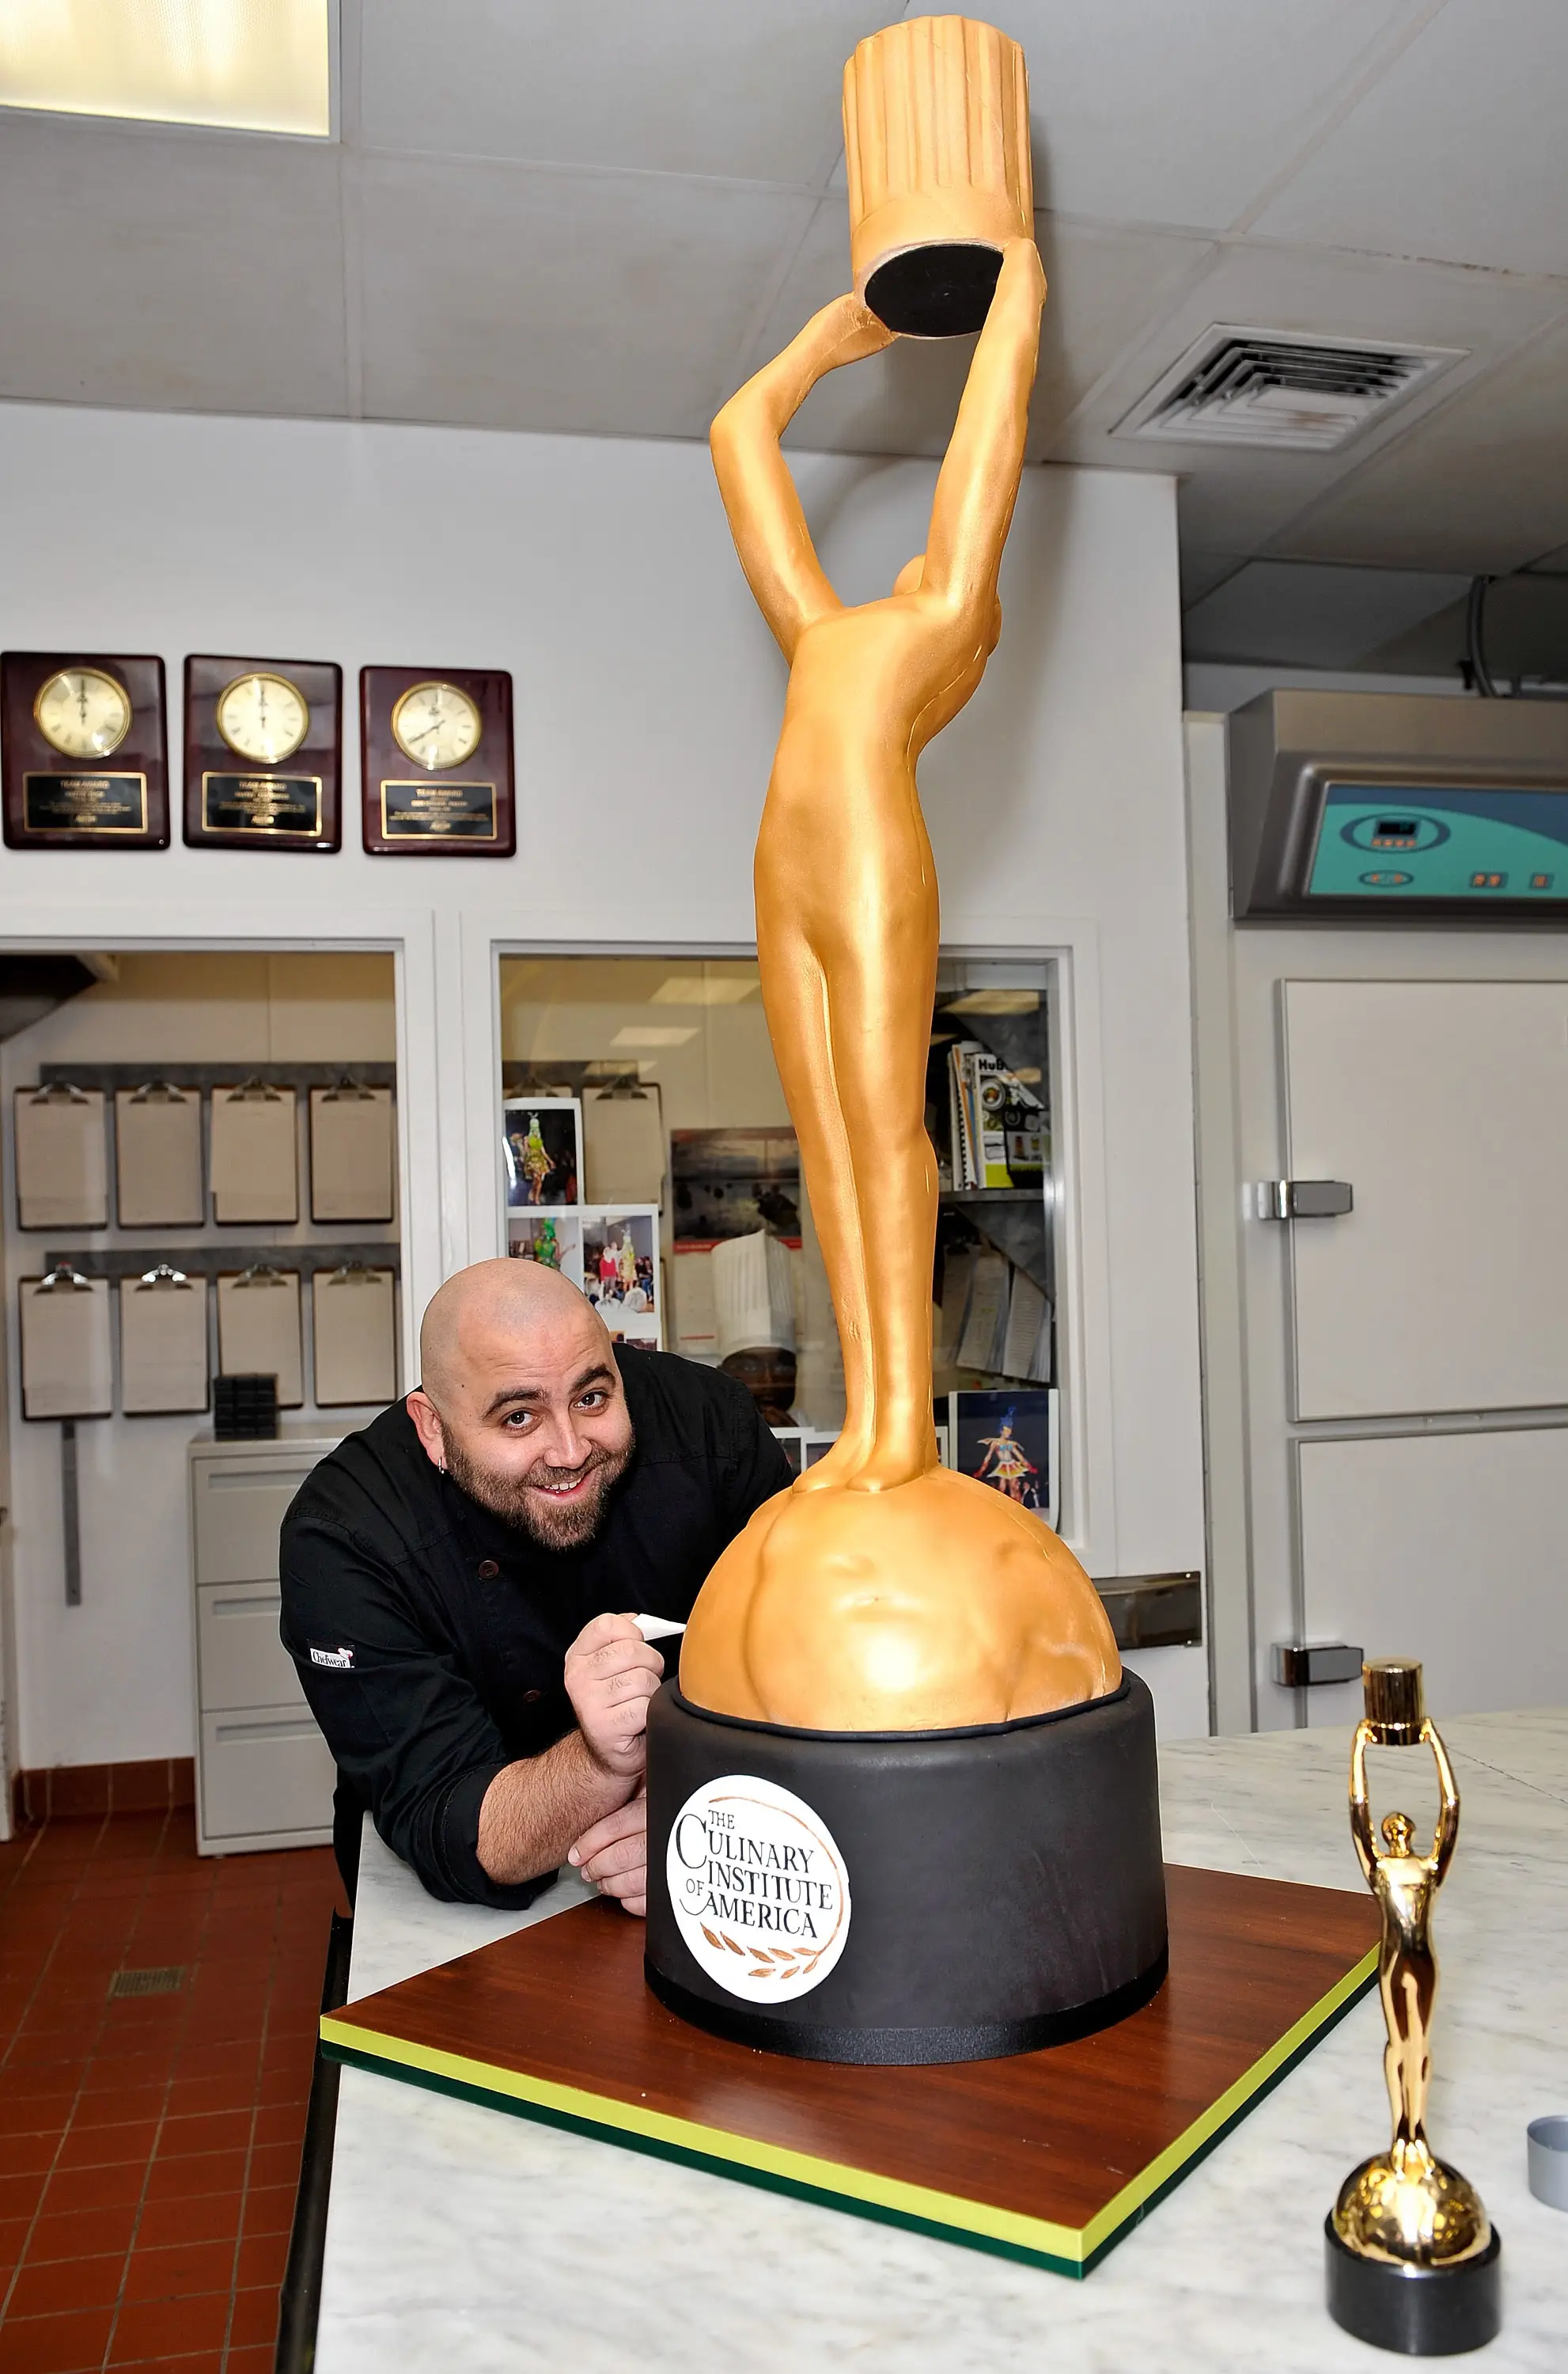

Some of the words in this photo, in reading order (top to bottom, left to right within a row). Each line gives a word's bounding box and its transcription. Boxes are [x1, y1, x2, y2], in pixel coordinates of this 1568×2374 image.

[676, 1813, 815, 1874] CULINARY
[707, 1809, 736, 1830] THE
[685, 1878, 704, 1897] OF
[707, 1860, 833, 1910] INSTITUTE
[679, 1890, 818, 1939] AMERICA
